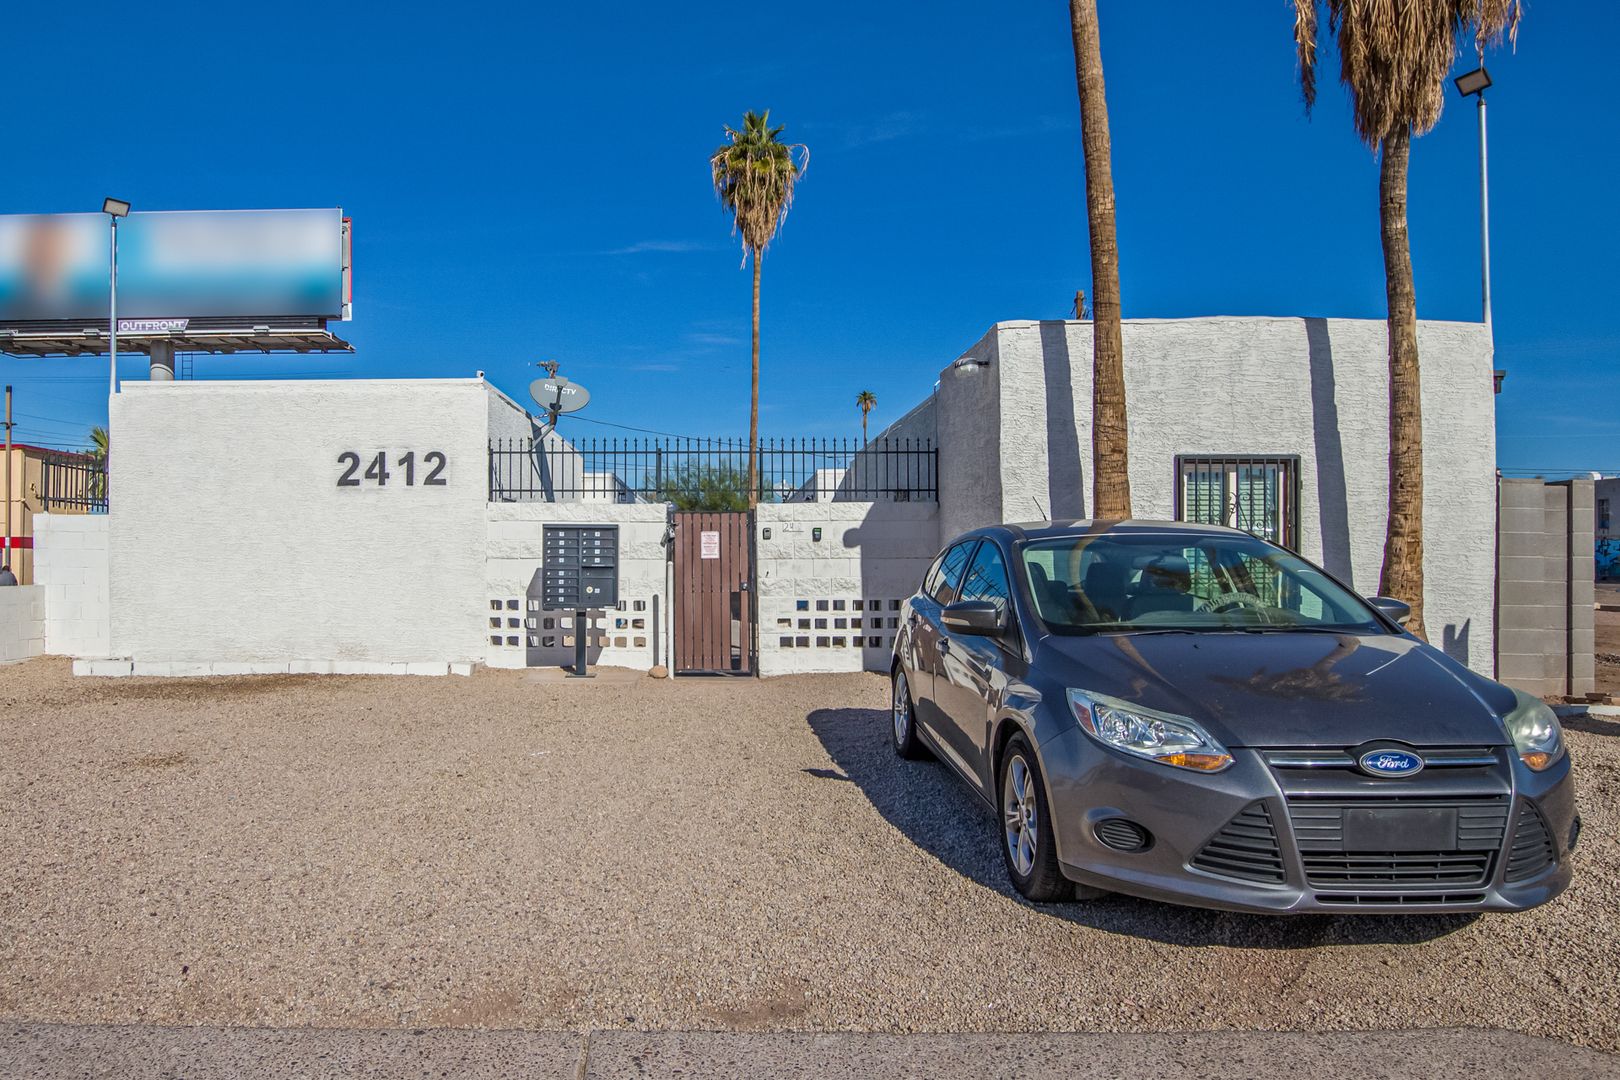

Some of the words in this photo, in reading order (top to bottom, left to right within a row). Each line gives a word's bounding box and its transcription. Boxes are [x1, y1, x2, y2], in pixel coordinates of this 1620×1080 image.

[120, 321, 184, 331] OUTFRONT
[544, 383, 577, 395] DIRCTV
[336, 451, 447, 487] 2412
[1377, 754, 1410, 769] Ford
